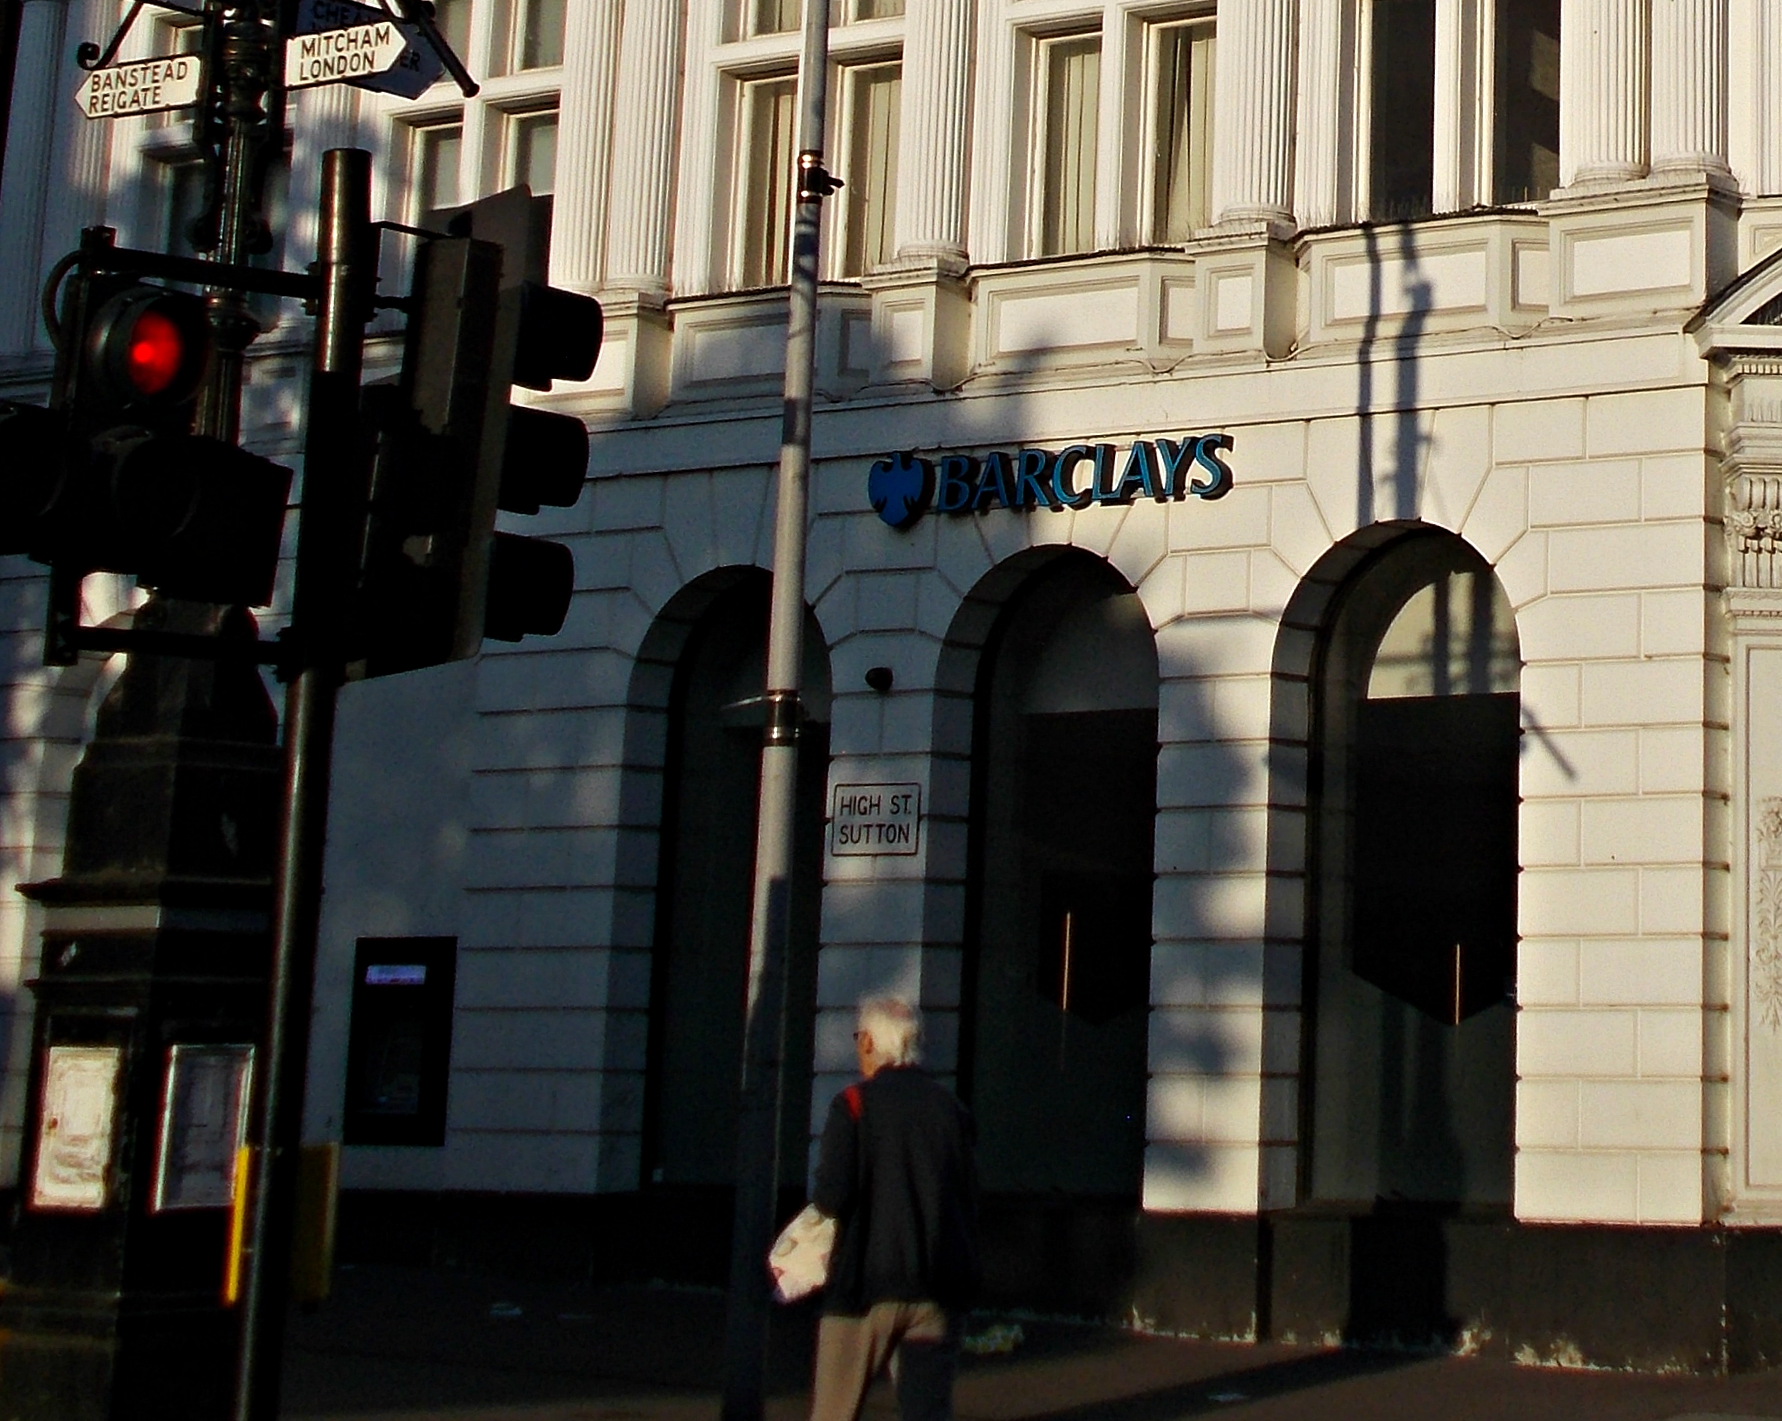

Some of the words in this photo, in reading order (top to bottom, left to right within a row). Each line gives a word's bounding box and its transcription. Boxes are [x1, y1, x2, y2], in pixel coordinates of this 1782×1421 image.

[313, 0, 372, 25] CHEA
[301, 26, 391, 59] MITCHAM
[91, 61, 188, 93] BANSTEAD
[300, 51, 376, 80] LONDON
[89, 86, 162, 114] REIGATE
[936, 434, 1230, 512] BARCLAYS
[840, 795, 881, 816] HIGH
[890, 794, 912, 815] ST.
[839, 823, 910, 844] SUTTON
